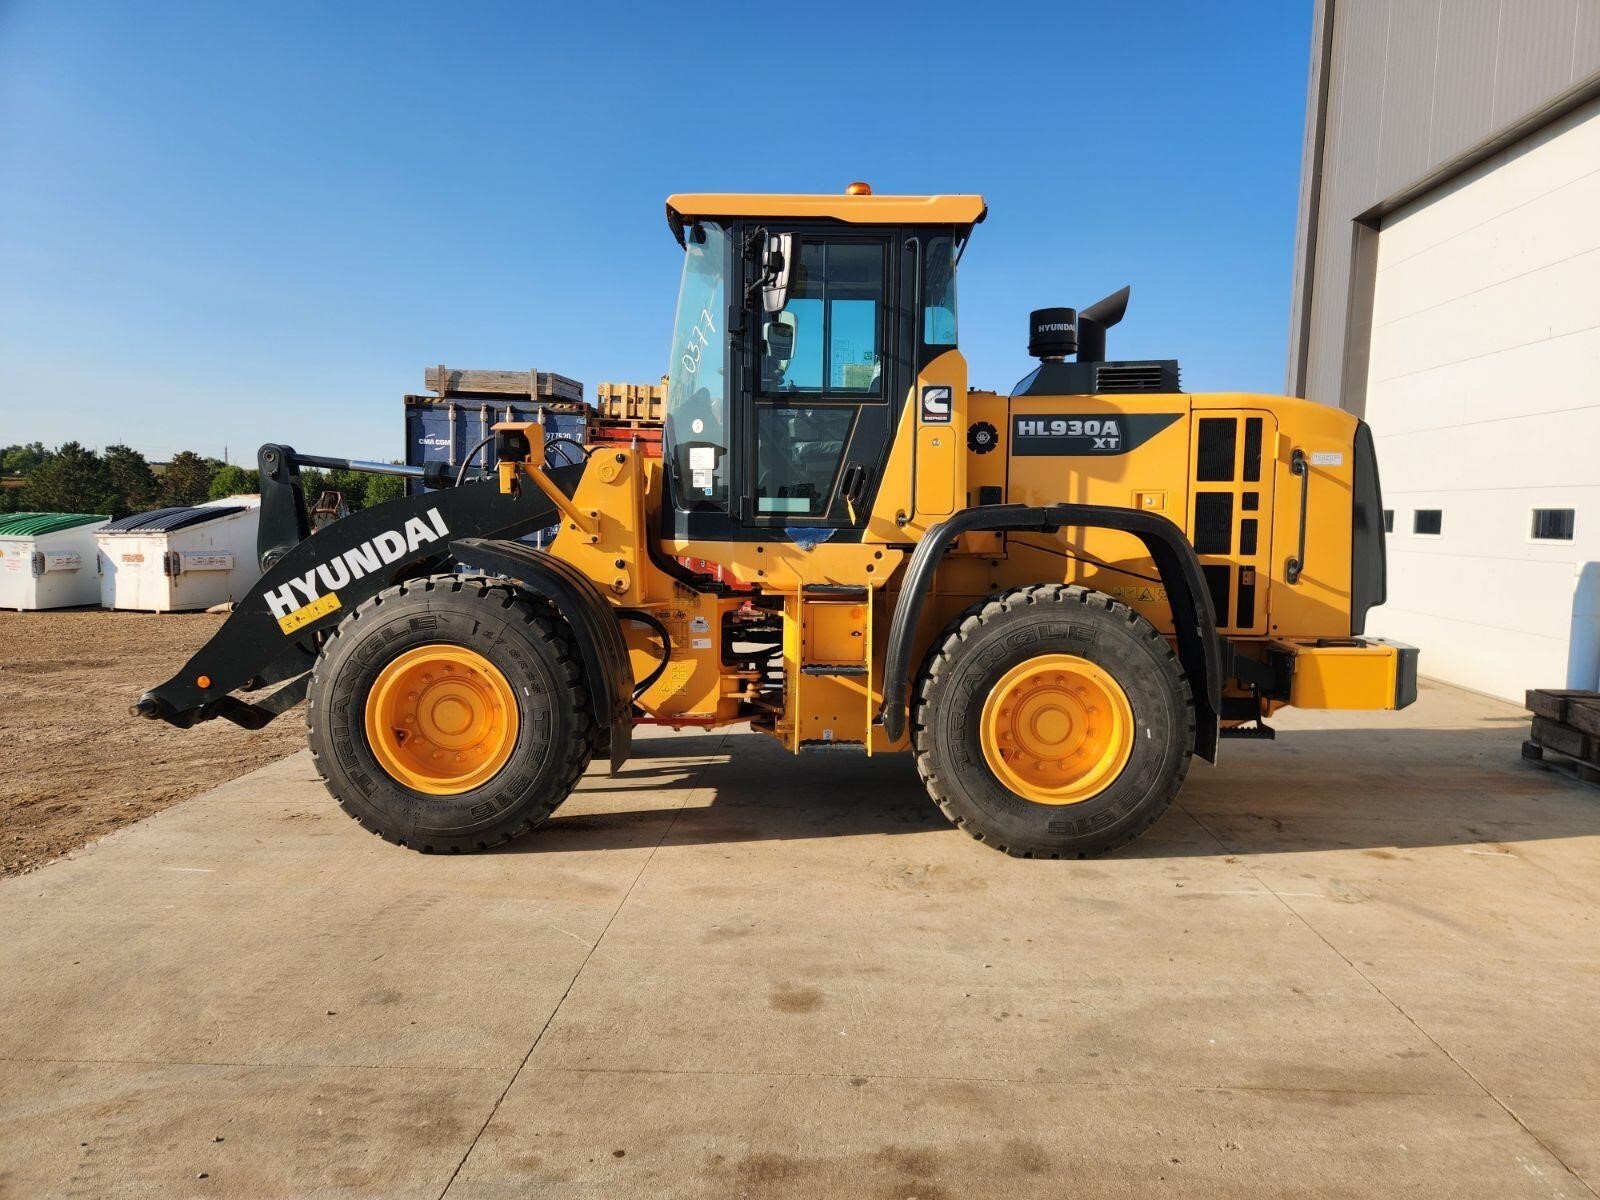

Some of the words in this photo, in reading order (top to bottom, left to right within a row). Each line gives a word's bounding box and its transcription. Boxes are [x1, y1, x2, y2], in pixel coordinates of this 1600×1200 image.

[682, 309, 716, 374] 0377
[1017, 420, 1119, 436] HL930A
[545, 432, 571, 441] 977520
[1093, 437, 1120, 449] XT
[263, 507, 450, 619] HYUNDAI
